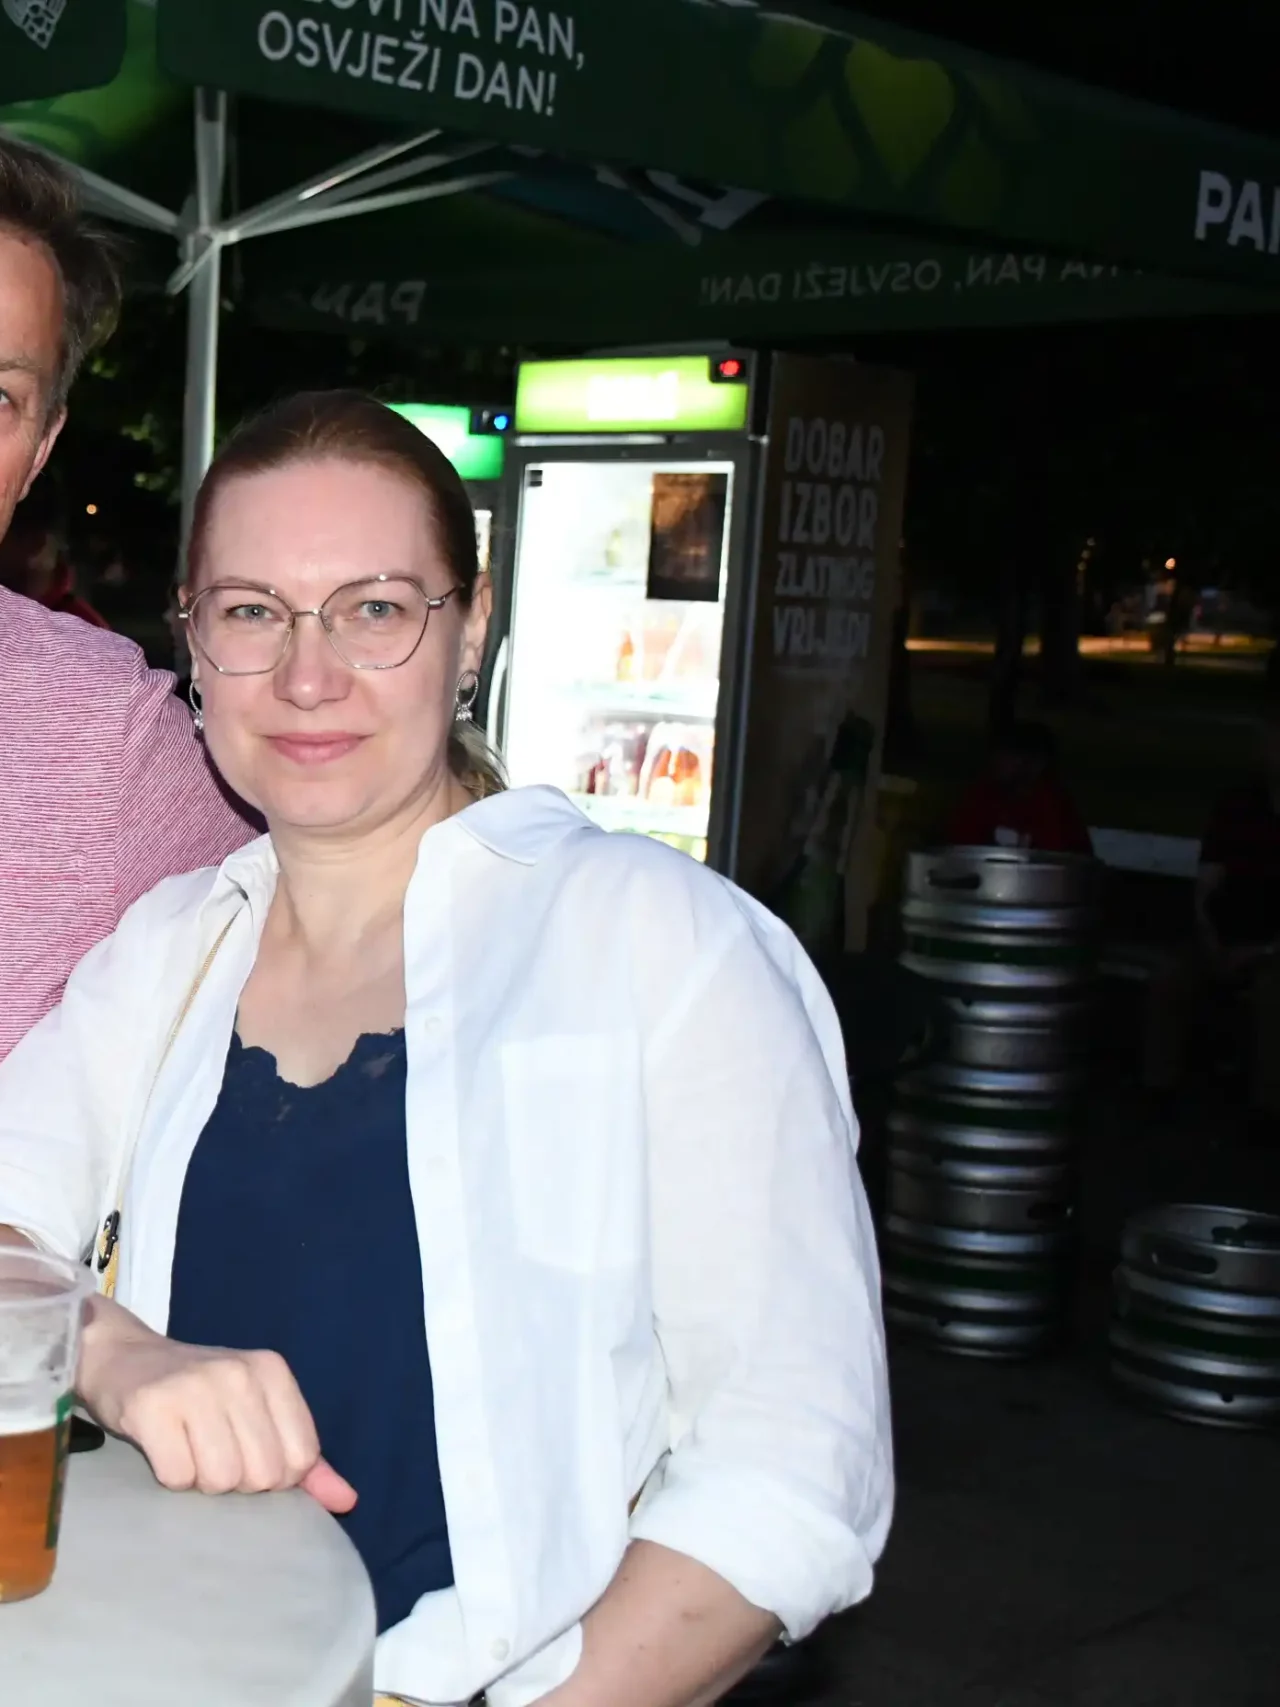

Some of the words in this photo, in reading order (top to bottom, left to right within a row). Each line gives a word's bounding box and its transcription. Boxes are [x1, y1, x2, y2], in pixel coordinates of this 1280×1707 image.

[258, 11, 441, 92] OSVJEŽI
[454, 52, 557, 116] DAN!
[419, 0, 480, 39] NA
[494, 0, 585, 70] PAN,
[784, 416, 885, 482] DOBAR
[778, 480, 878, 550] IZBOR
